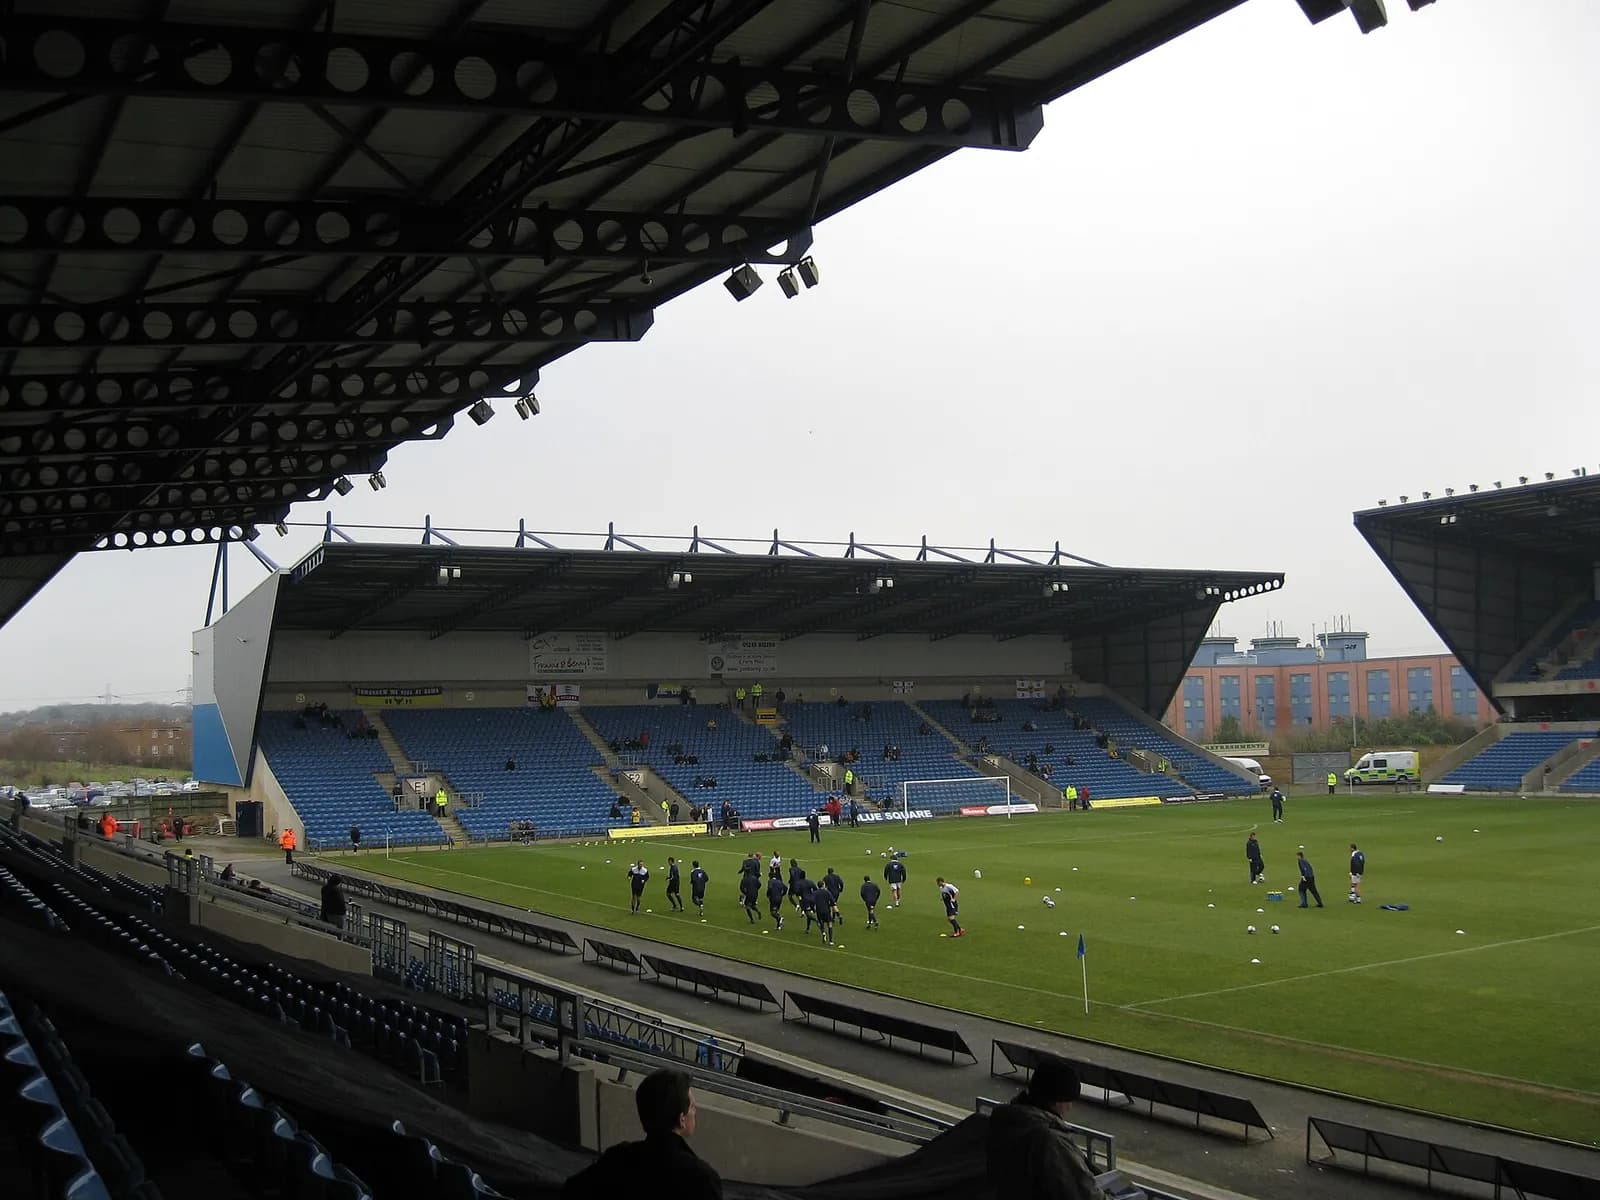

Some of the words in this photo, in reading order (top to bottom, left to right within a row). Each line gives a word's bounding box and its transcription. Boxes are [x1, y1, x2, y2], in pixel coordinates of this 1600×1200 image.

[415, 781, 426, 795] E1
[857, 812, 884, 822] LUE
[885, 809, 934, 821] SQUARE
